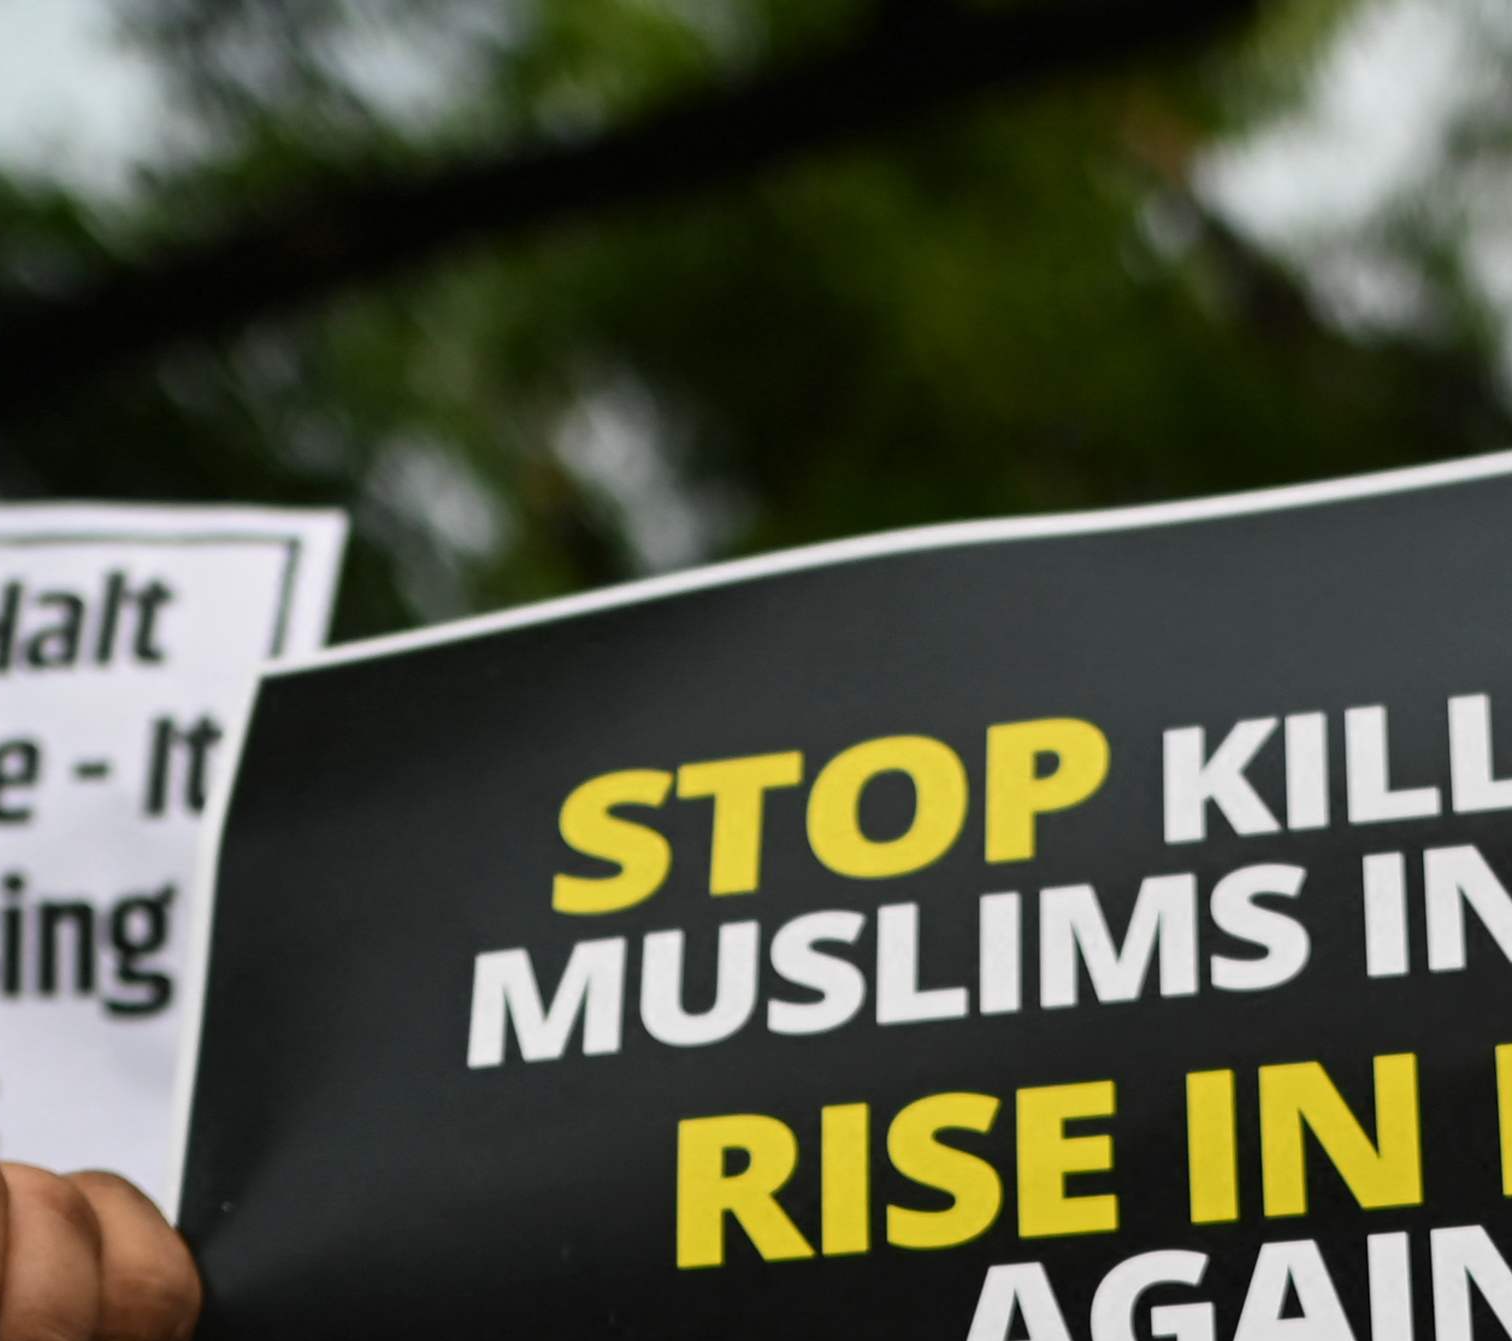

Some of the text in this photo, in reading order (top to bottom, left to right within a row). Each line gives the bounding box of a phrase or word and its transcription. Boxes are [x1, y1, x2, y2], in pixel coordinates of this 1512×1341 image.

[142, 712, 224, 820] It
[551, 716, 1111, 915] STOP
[466, 862, 1312, 1069] MUSLIMS
[676, 1079, 1119, 1270] RISE
[1184, 1052, 1424, 1226] IN
